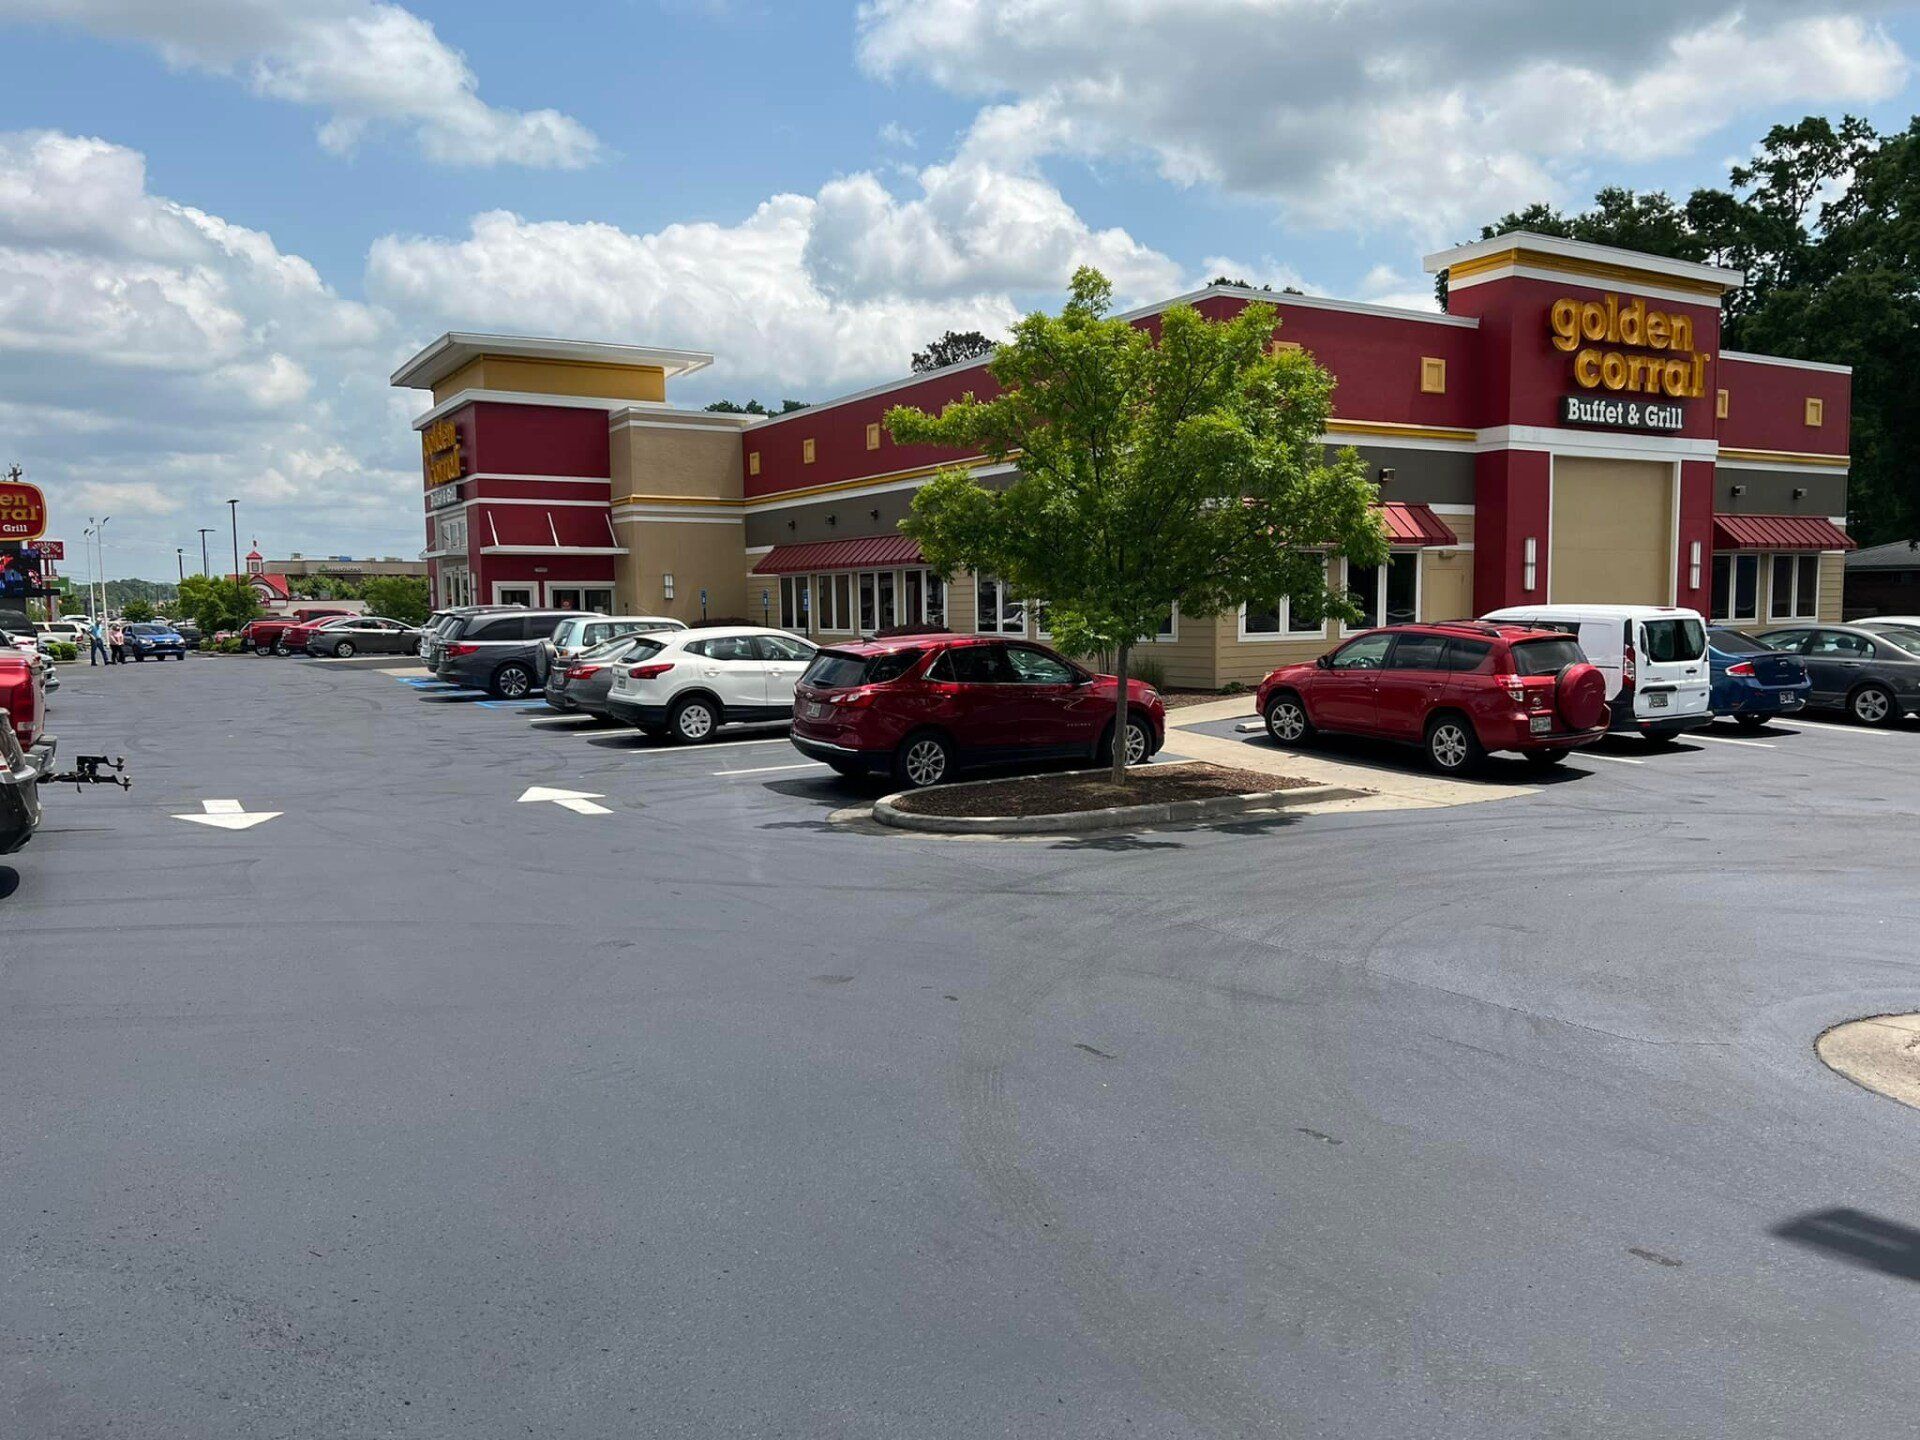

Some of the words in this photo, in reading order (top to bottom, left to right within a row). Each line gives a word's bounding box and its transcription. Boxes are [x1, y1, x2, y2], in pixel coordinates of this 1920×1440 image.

[1552, 294, 1693, 351] golden
[1575, 349, 1705, 397] corral
[1567, 397, 1623, 424] Buffet
[1627, 403, 1640, 425] &
[1645, 405, 1683, 429] Grill
[2, 524, 29, 532] Grill
